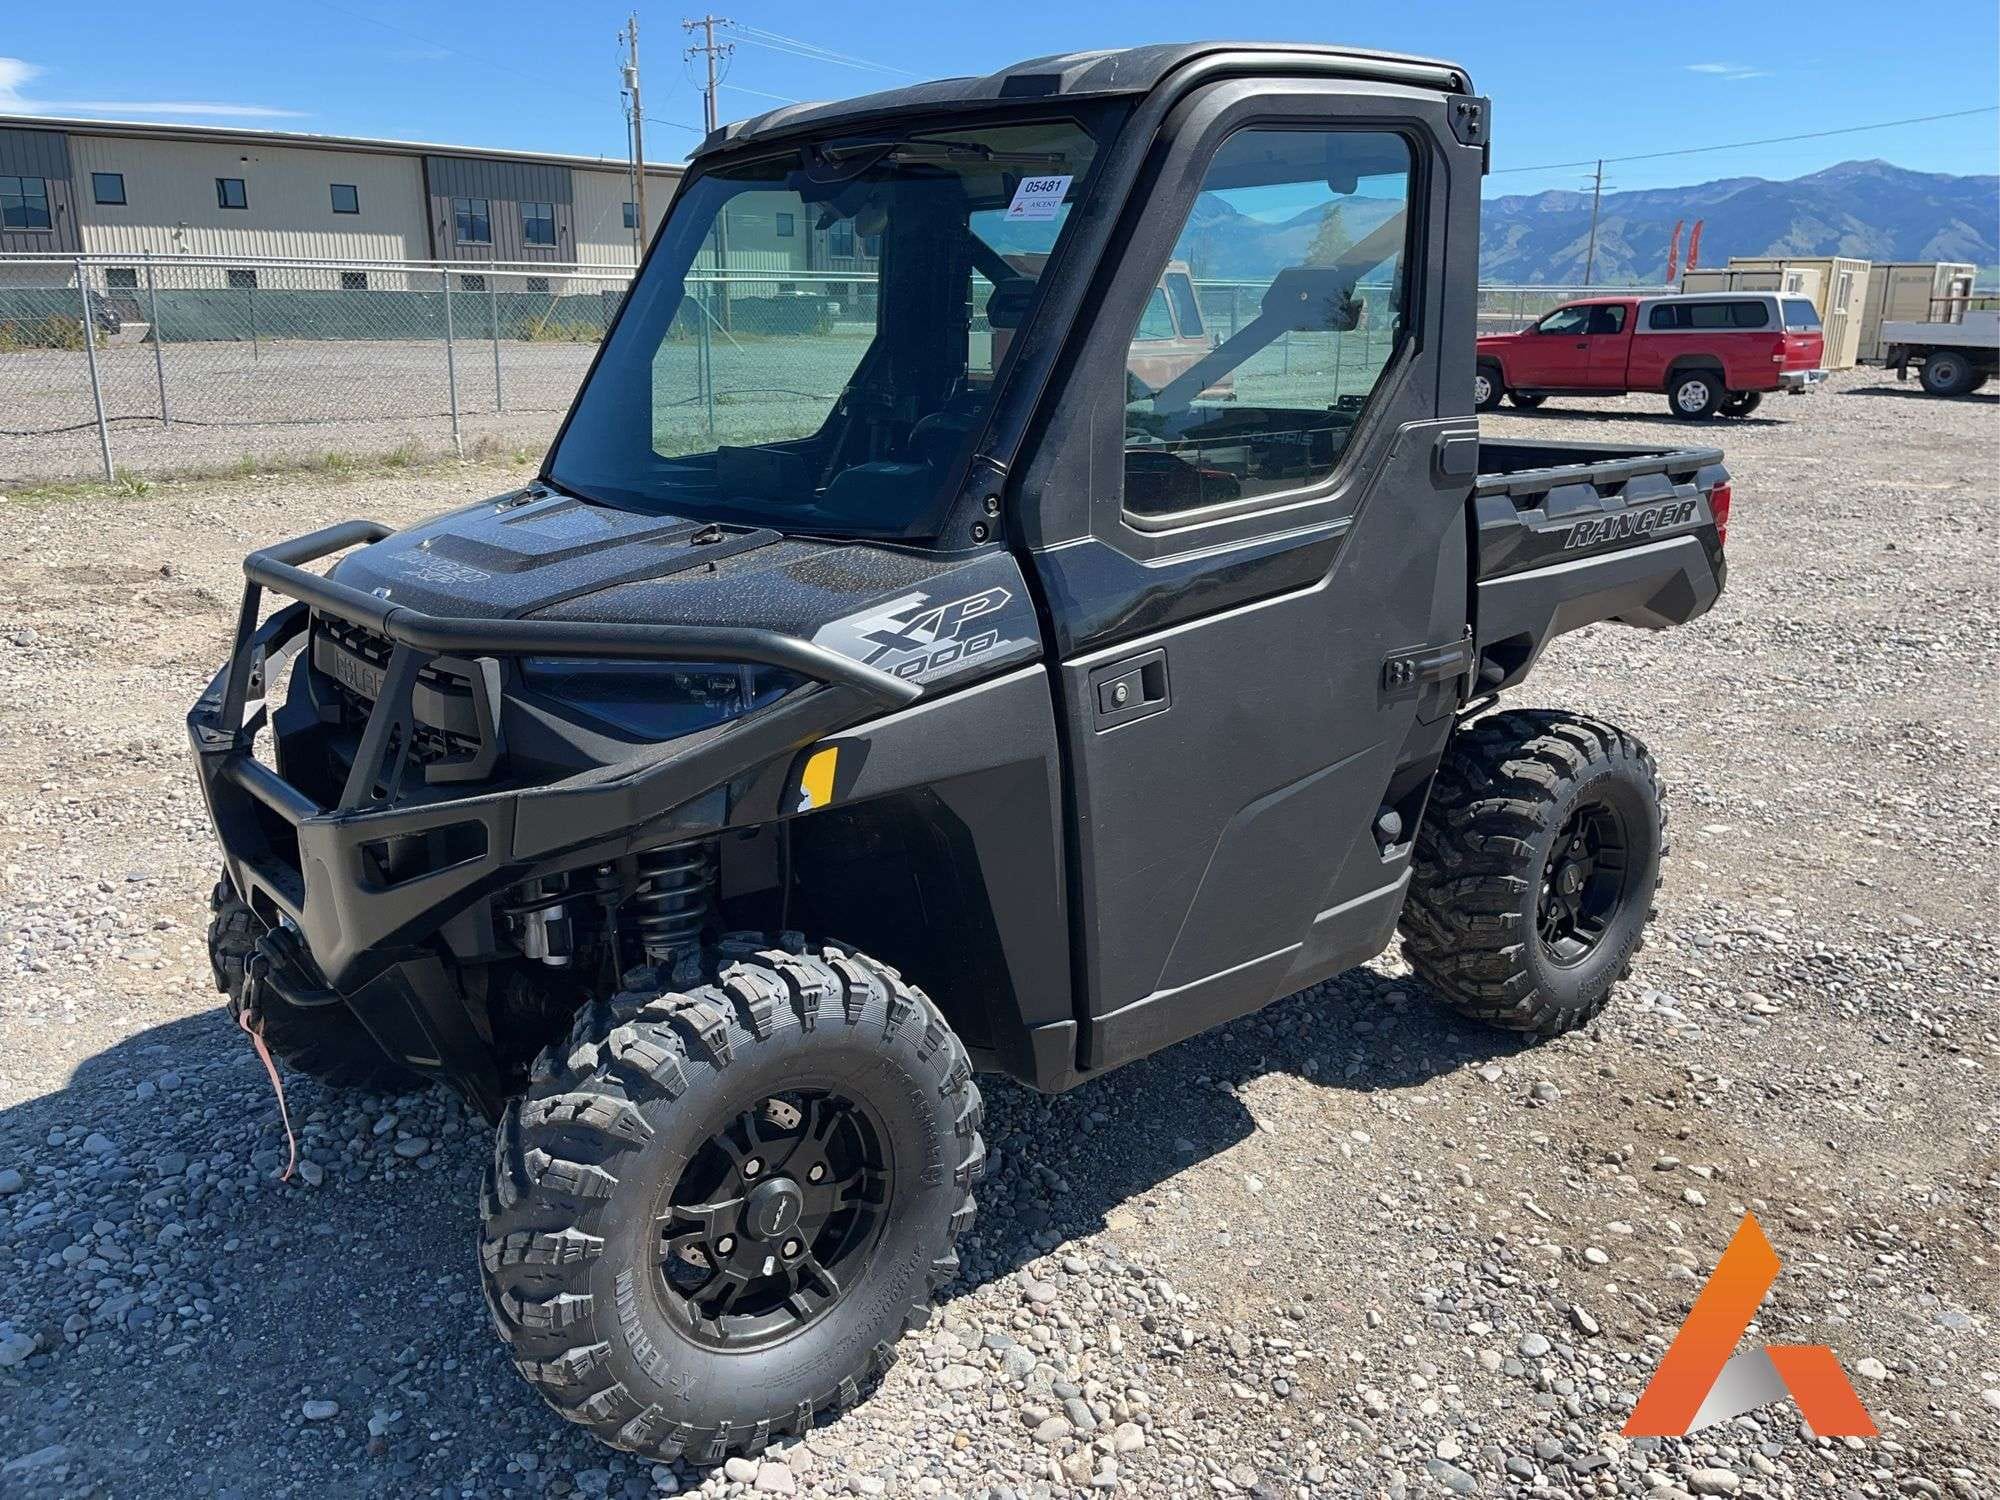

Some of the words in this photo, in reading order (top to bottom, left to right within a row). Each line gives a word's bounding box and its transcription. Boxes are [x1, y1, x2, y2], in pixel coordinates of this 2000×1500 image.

[1025, 180, 1062, 193] 05481
[1564, 500, 1697, 549] RANGER
[856, 586, 1013, 666] XP
[335, 650, 385, 698] POLA
[614, 1265, 699, 1403] X-TERRAIN
